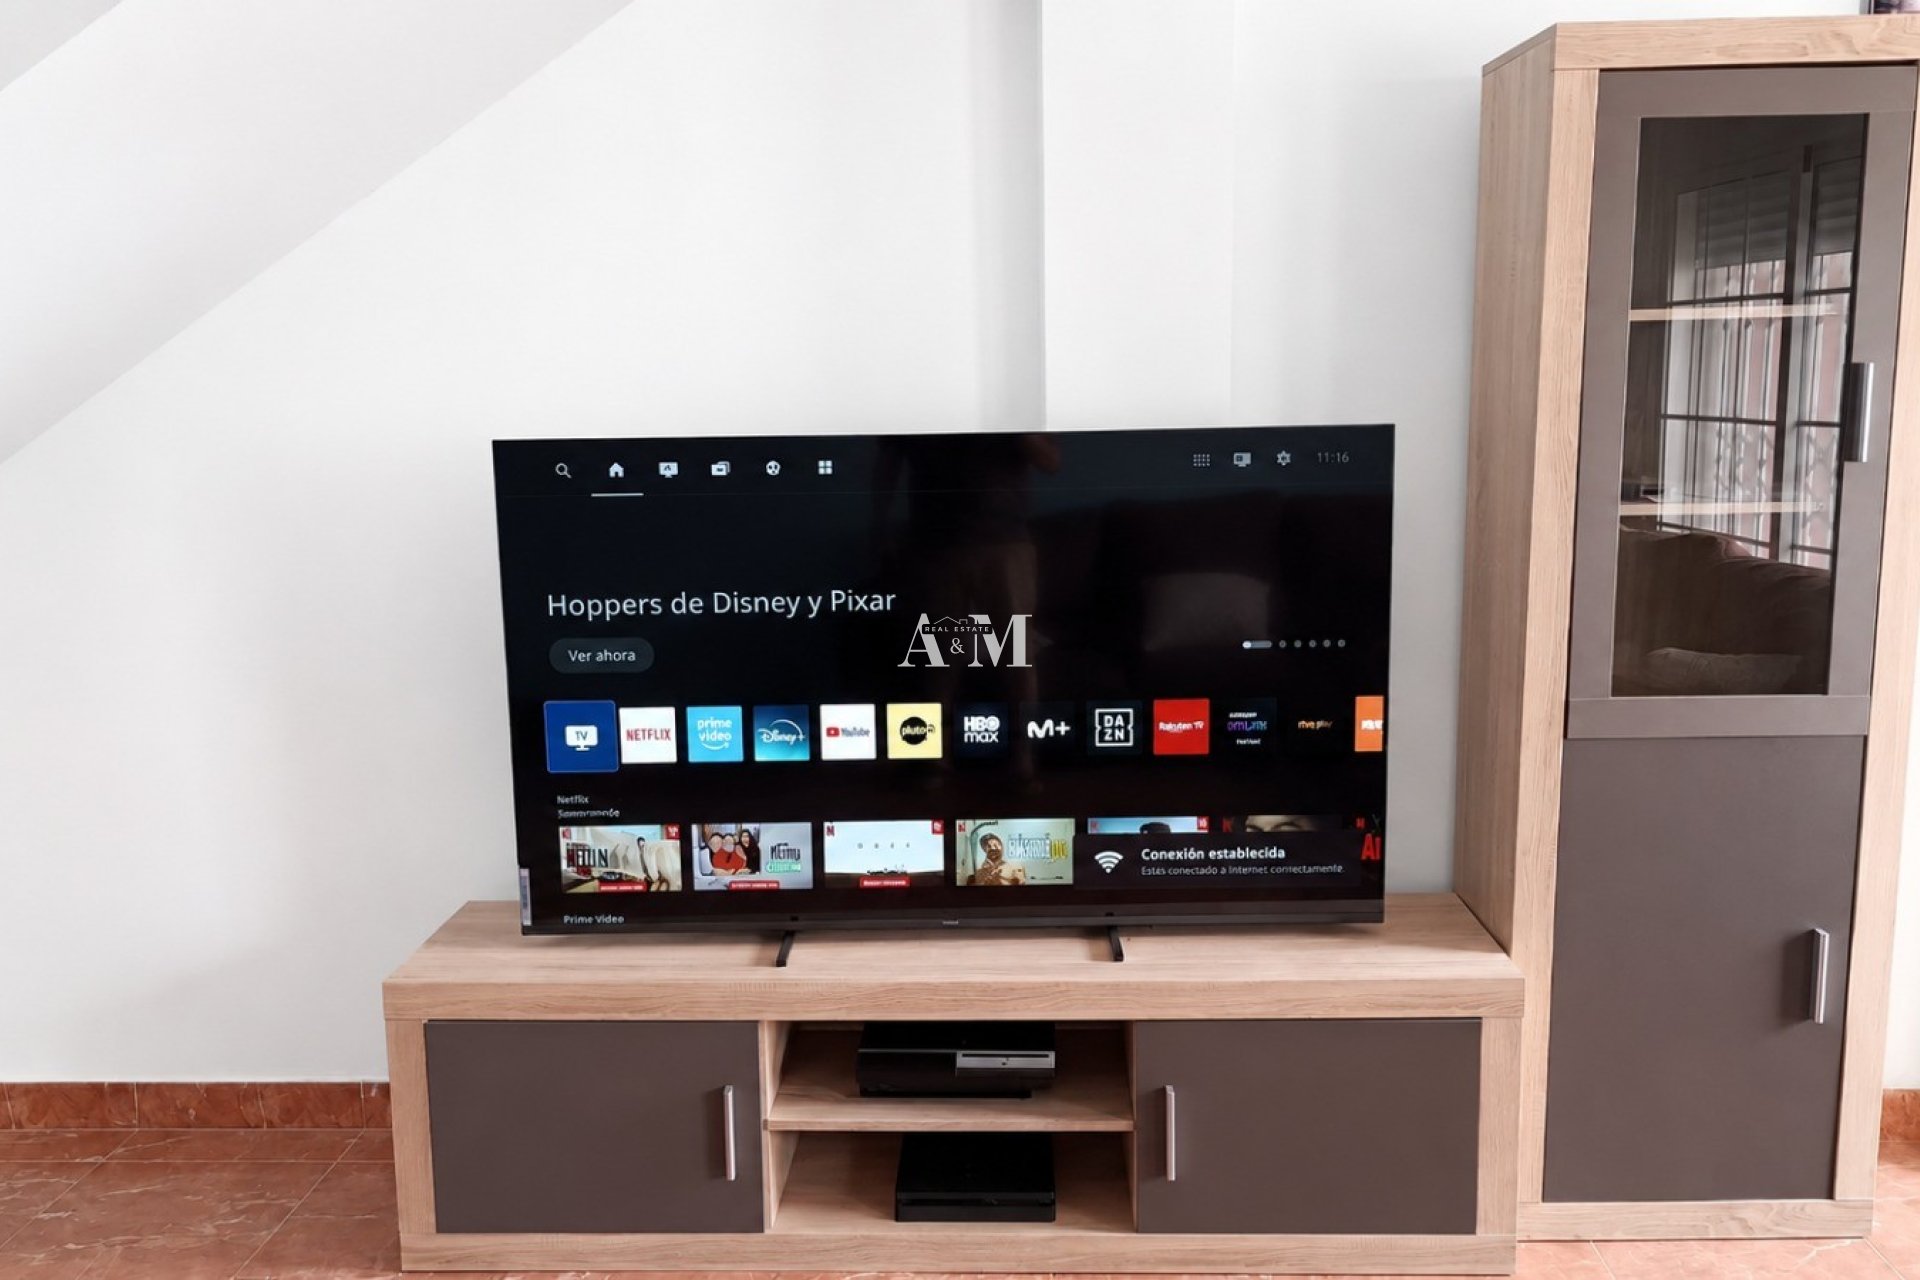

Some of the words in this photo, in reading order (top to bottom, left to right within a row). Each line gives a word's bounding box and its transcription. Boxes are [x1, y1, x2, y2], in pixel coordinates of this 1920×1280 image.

[1317, 451, 1350, 464] 11:16
[547, 594, 662, 621] Hoppers
[671, 592, 704, 615] de
[713, 591, 800, 618] Disney
[807, 597, 823, 618] y
[831, 590, 896, 613] Pixar
[567, 649, 592, 662] Ver
[597, 648, 636, 662] ahora
[697, 716, 733, 730] prime
[963, 715, 1000, 732] HBO
[1158, 721, 1193, 733] Rakuten
[574, 730, 589, 741] TV
[626, 728, 672, 742] NETFLIX
[698, 729, 733, 742] video
[841, 727, 870, 738] YouTube
[963, 730, 999, 743] max
[1141, 848, 1205, 861] Conexión
[1208, 846, 1286, 860] establecida
[1168, 865, 1218, 875] conectado
[1228, 864, 1268, 874] Internet
[563, 915, 593, 925] Prime
[594, 914, 625, 925] Video
